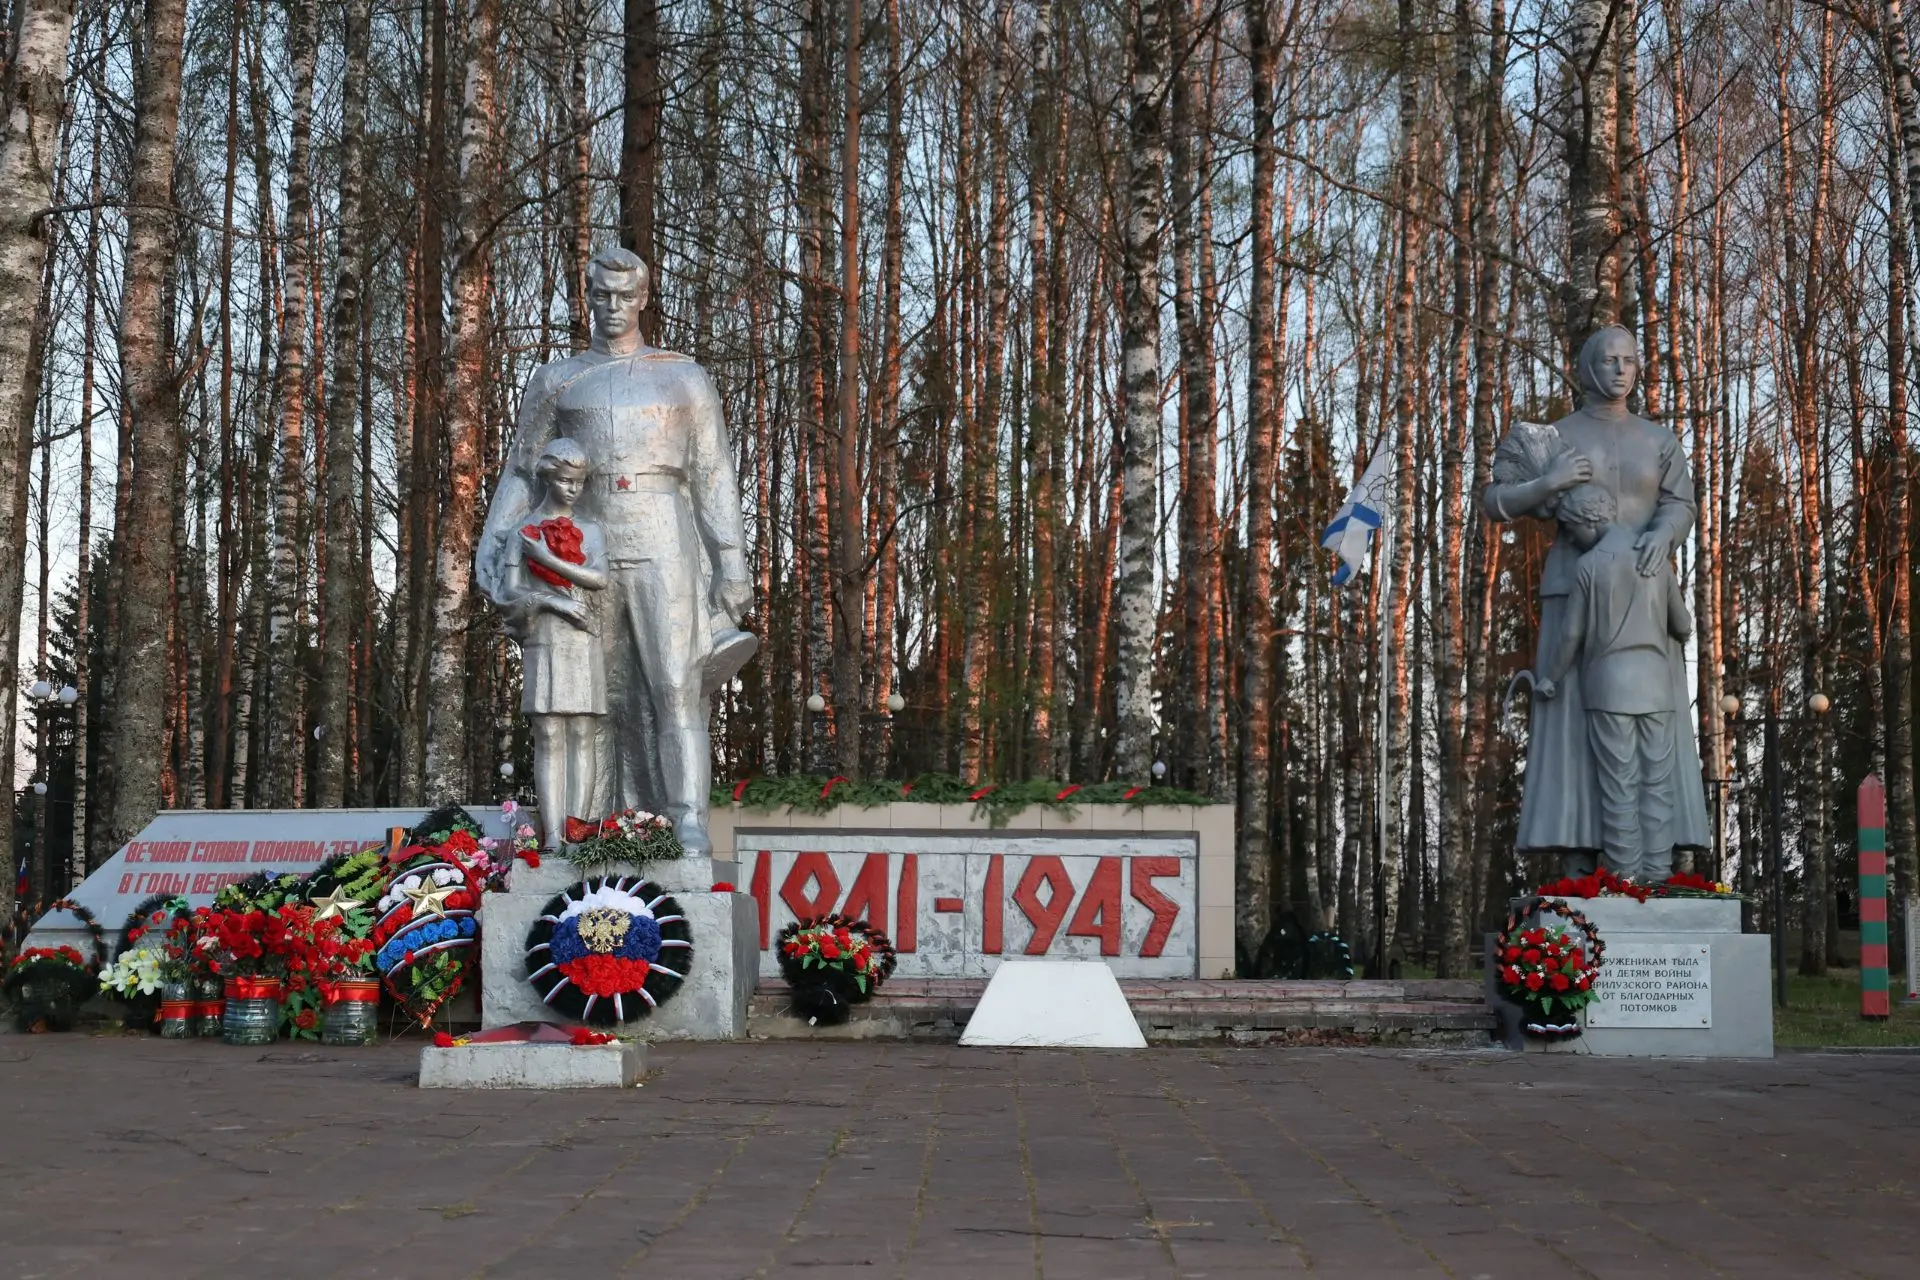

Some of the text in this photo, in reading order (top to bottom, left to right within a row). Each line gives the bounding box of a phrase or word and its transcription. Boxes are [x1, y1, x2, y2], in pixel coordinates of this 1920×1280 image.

[124, 841, 192, 862] ВЕЧНАЯ
[190, 841, 250, 862] СЛАВА
[117, 873, 134, 894] В
[133, 873, 191, 895] ГОДЫ
[1600, 957, 1699, 966] РУЖЕНИКАМ ТЫЛА
[1604, 968, 1692, 978] И ДЕТЯМ ВОЙНЫ
[1666, 980, 1708, 990] РАЙОНА
[1602, 992, 1695, 1001] ОТ БЛАГОДАРНЫХ
[1620, 1004, 1678, 1012] ПОТОМКОВ
